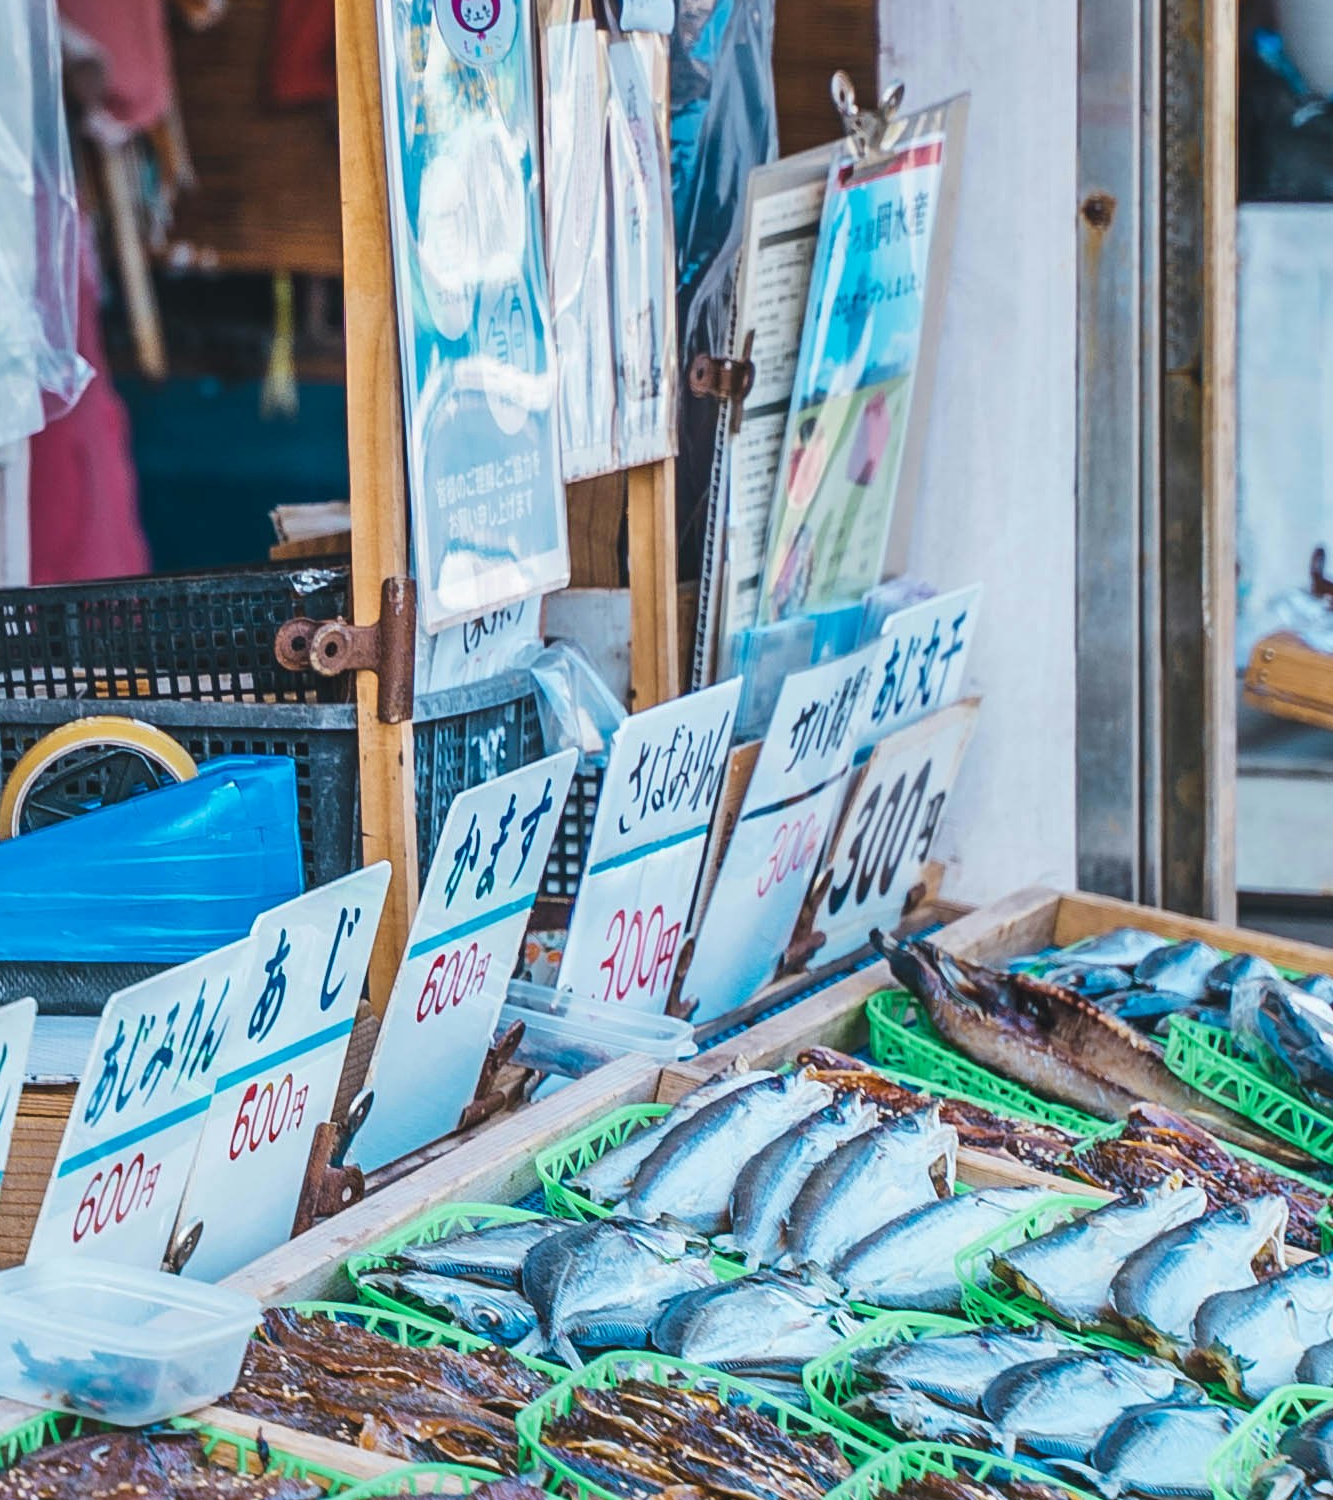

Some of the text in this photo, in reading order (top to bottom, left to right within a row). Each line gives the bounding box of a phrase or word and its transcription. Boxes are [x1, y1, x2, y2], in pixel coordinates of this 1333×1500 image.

[619, 710, 732, 835] さばみりん
[444, 777, 554, 911] かます
[828, 758, 947, 917] 300円
[247, 907, 362, 1044] あじ
[416, 942, 493, 1024] 600円
[600, 904, 683, 1003] 300円
[84, 975, 231, 1128] あじみりん
[228, 1072, 310, 1162] 600円
[72, 1151, 162, 1245] 600円
